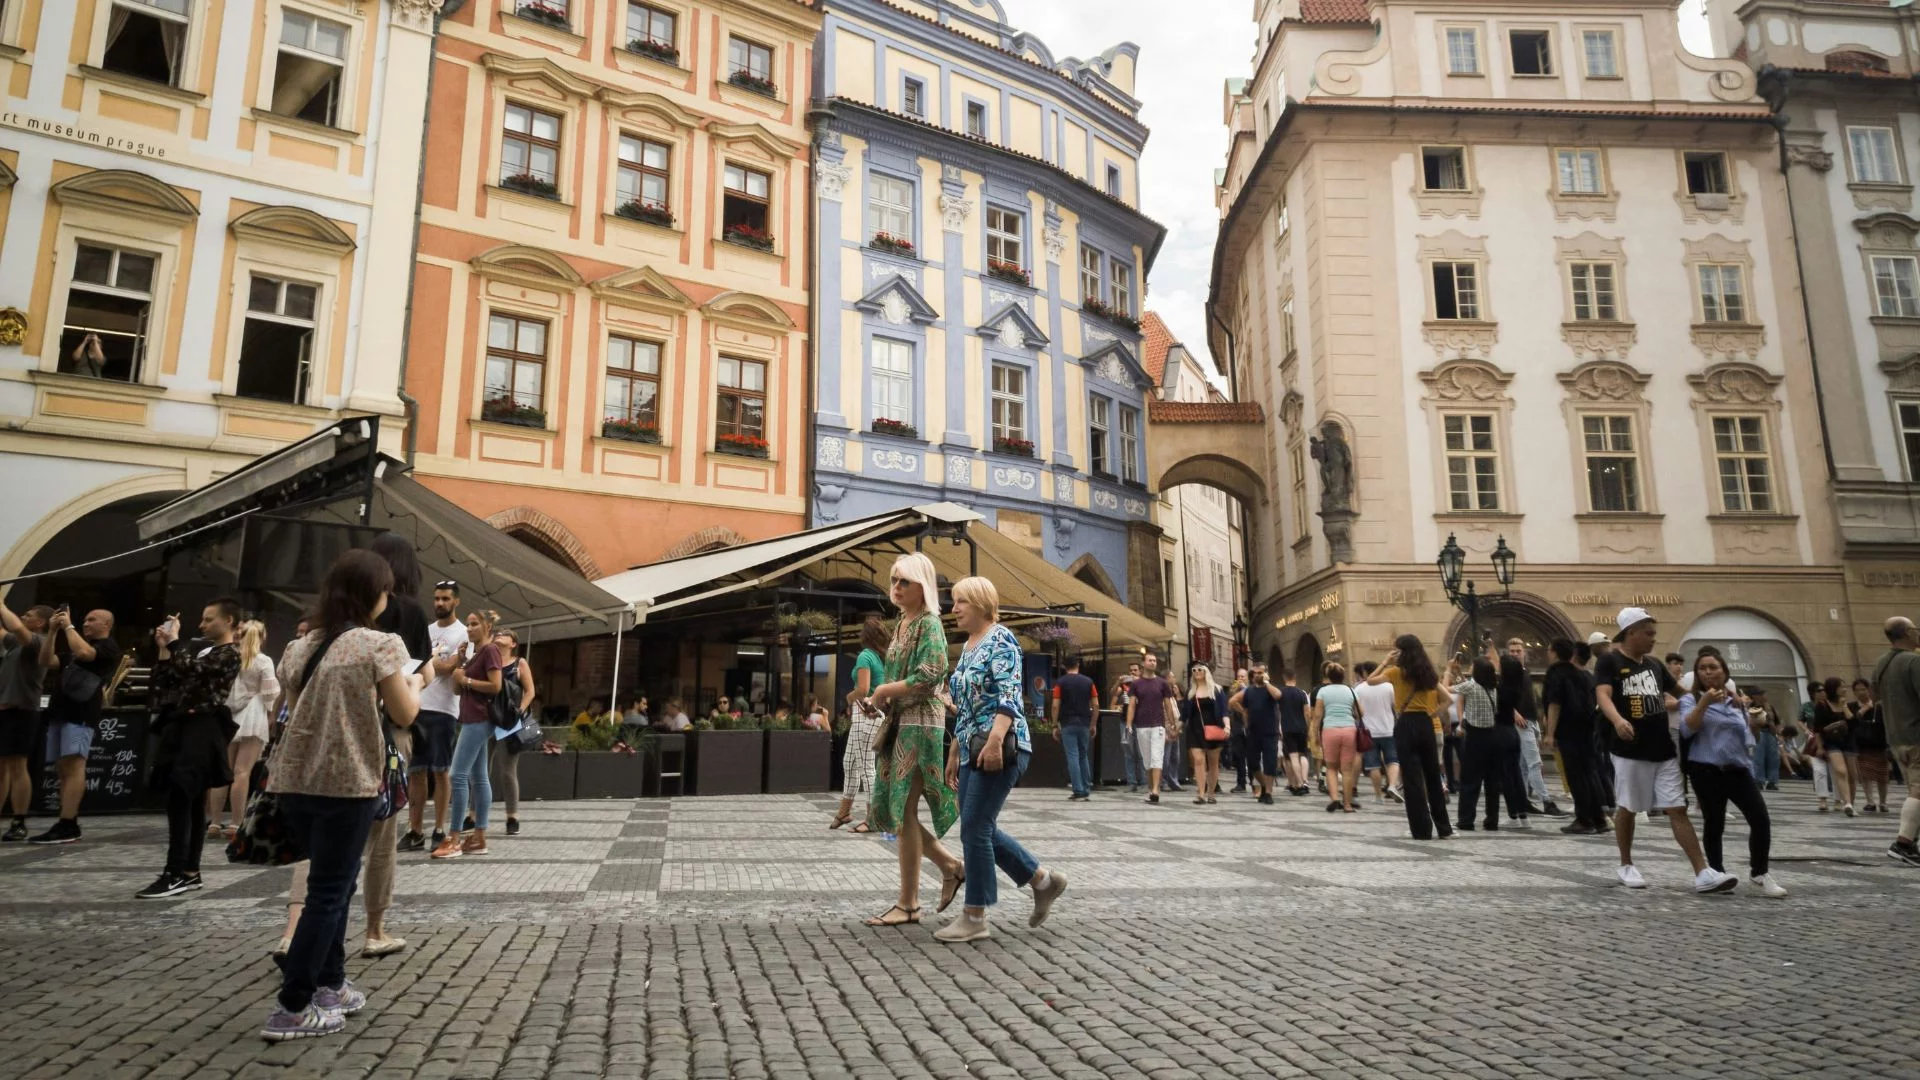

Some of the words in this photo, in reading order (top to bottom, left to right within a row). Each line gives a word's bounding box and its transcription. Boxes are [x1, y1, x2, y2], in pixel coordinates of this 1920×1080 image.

[3, 112, 18, 124] rt
[27, 117, 100, 143] museum
[106, 136, 166, 157] prague
